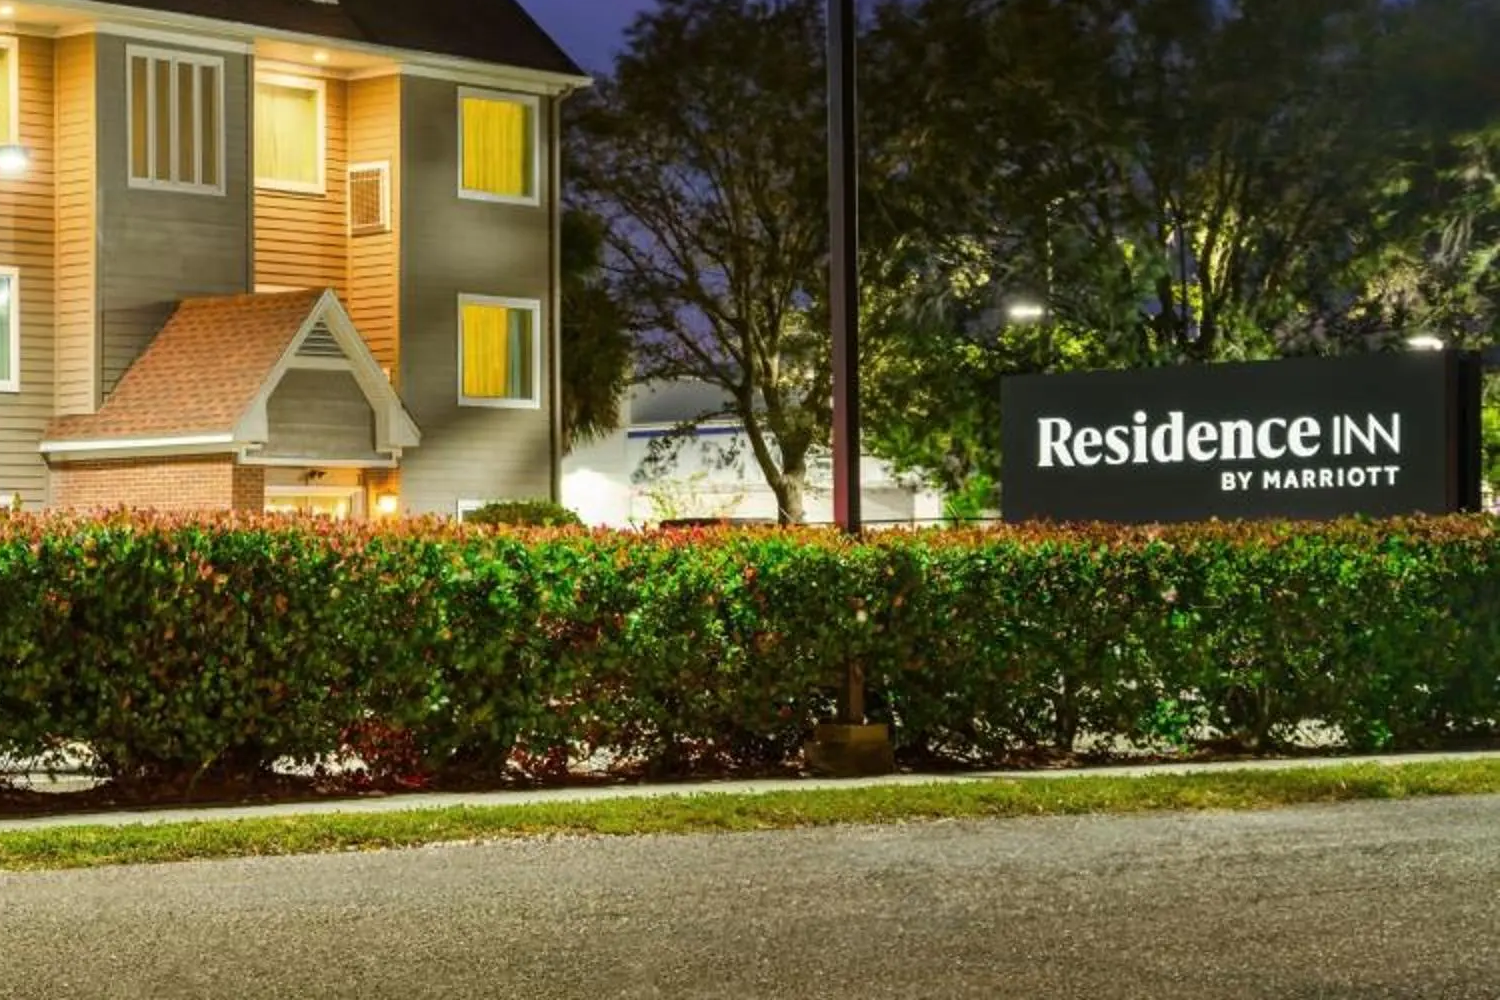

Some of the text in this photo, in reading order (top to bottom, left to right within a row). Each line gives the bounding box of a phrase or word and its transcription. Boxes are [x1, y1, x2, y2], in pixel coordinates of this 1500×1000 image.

[1037, 410, 1400, 467] Residence INN
[1221, 465, 1400, 491] BY MARRIOTT
